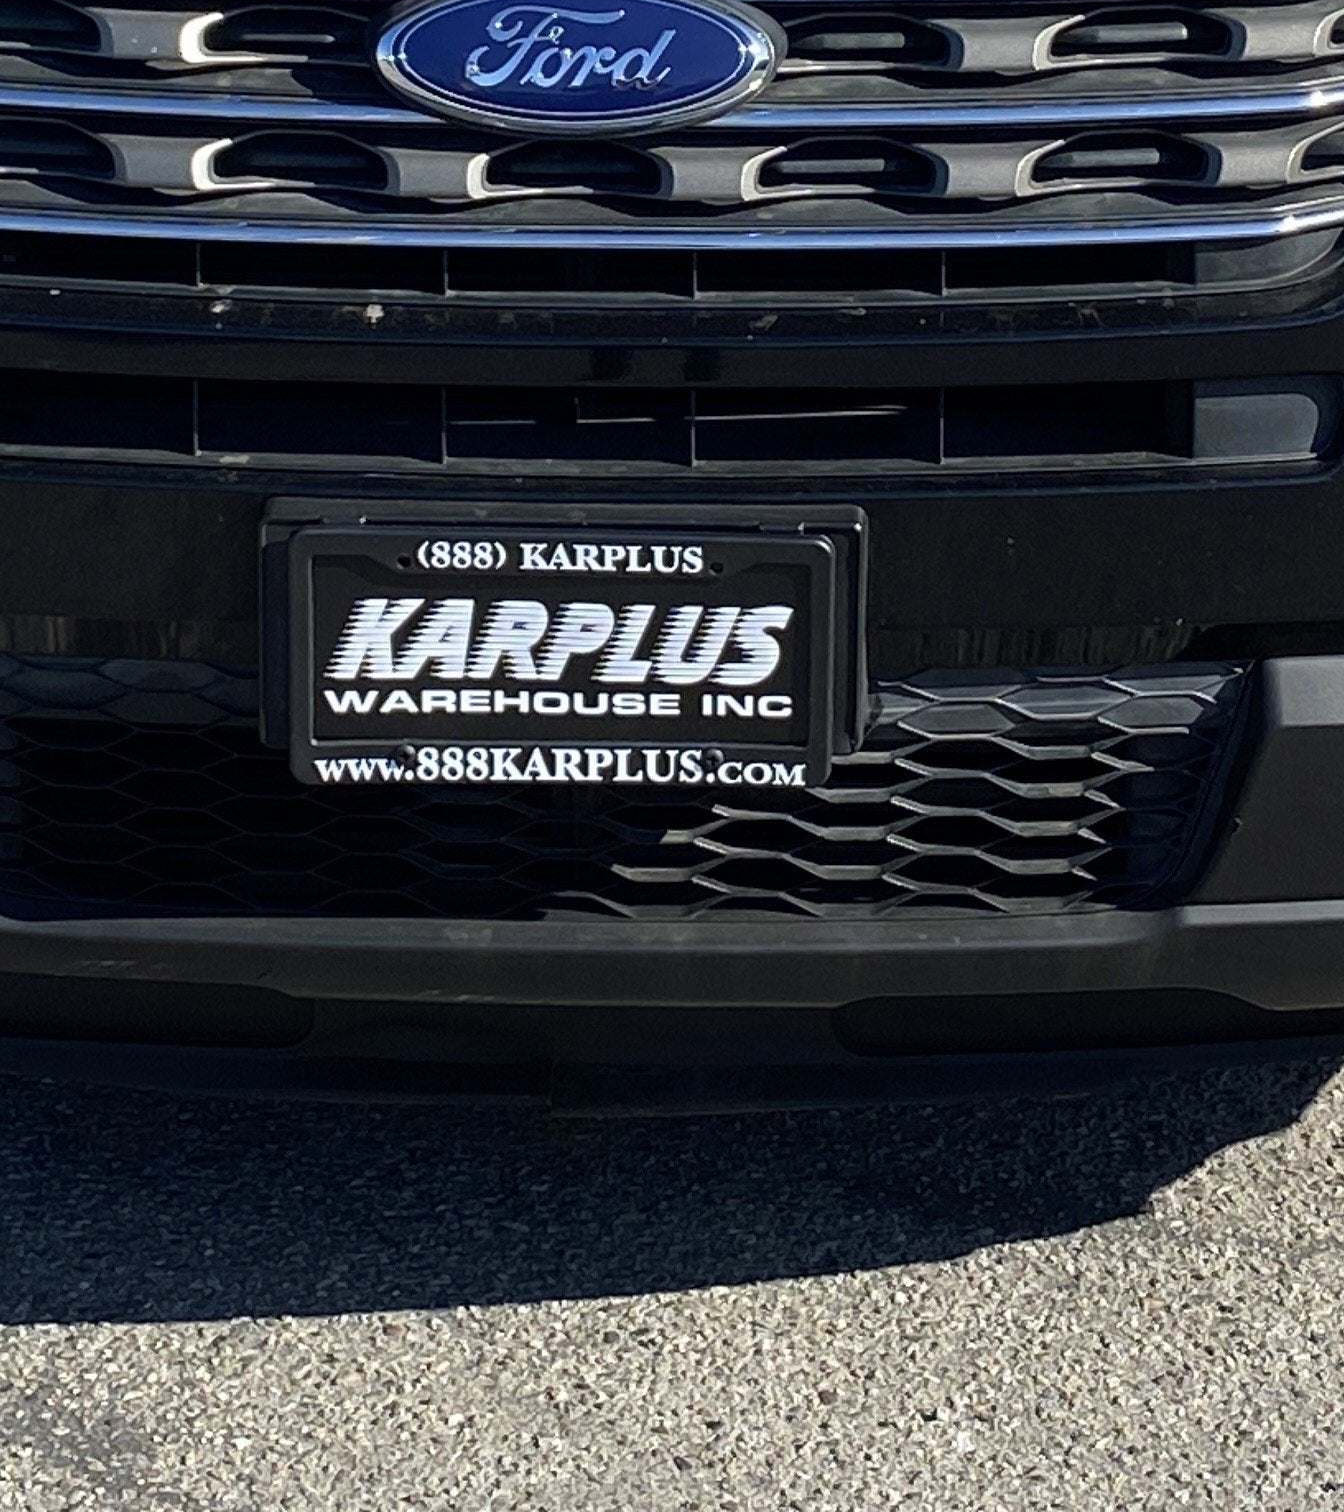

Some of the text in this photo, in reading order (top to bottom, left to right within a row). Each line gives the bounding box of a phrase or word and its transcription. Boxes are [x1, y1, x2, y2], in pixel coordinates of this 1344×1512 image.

[466, 4, 676, 89] Ford
[416, 539, 704, 574] (888) KARPLUS
[322, 597, 794, 687] KARPLUS
[323, 690, 794, 719] WAREHOUSE INC
